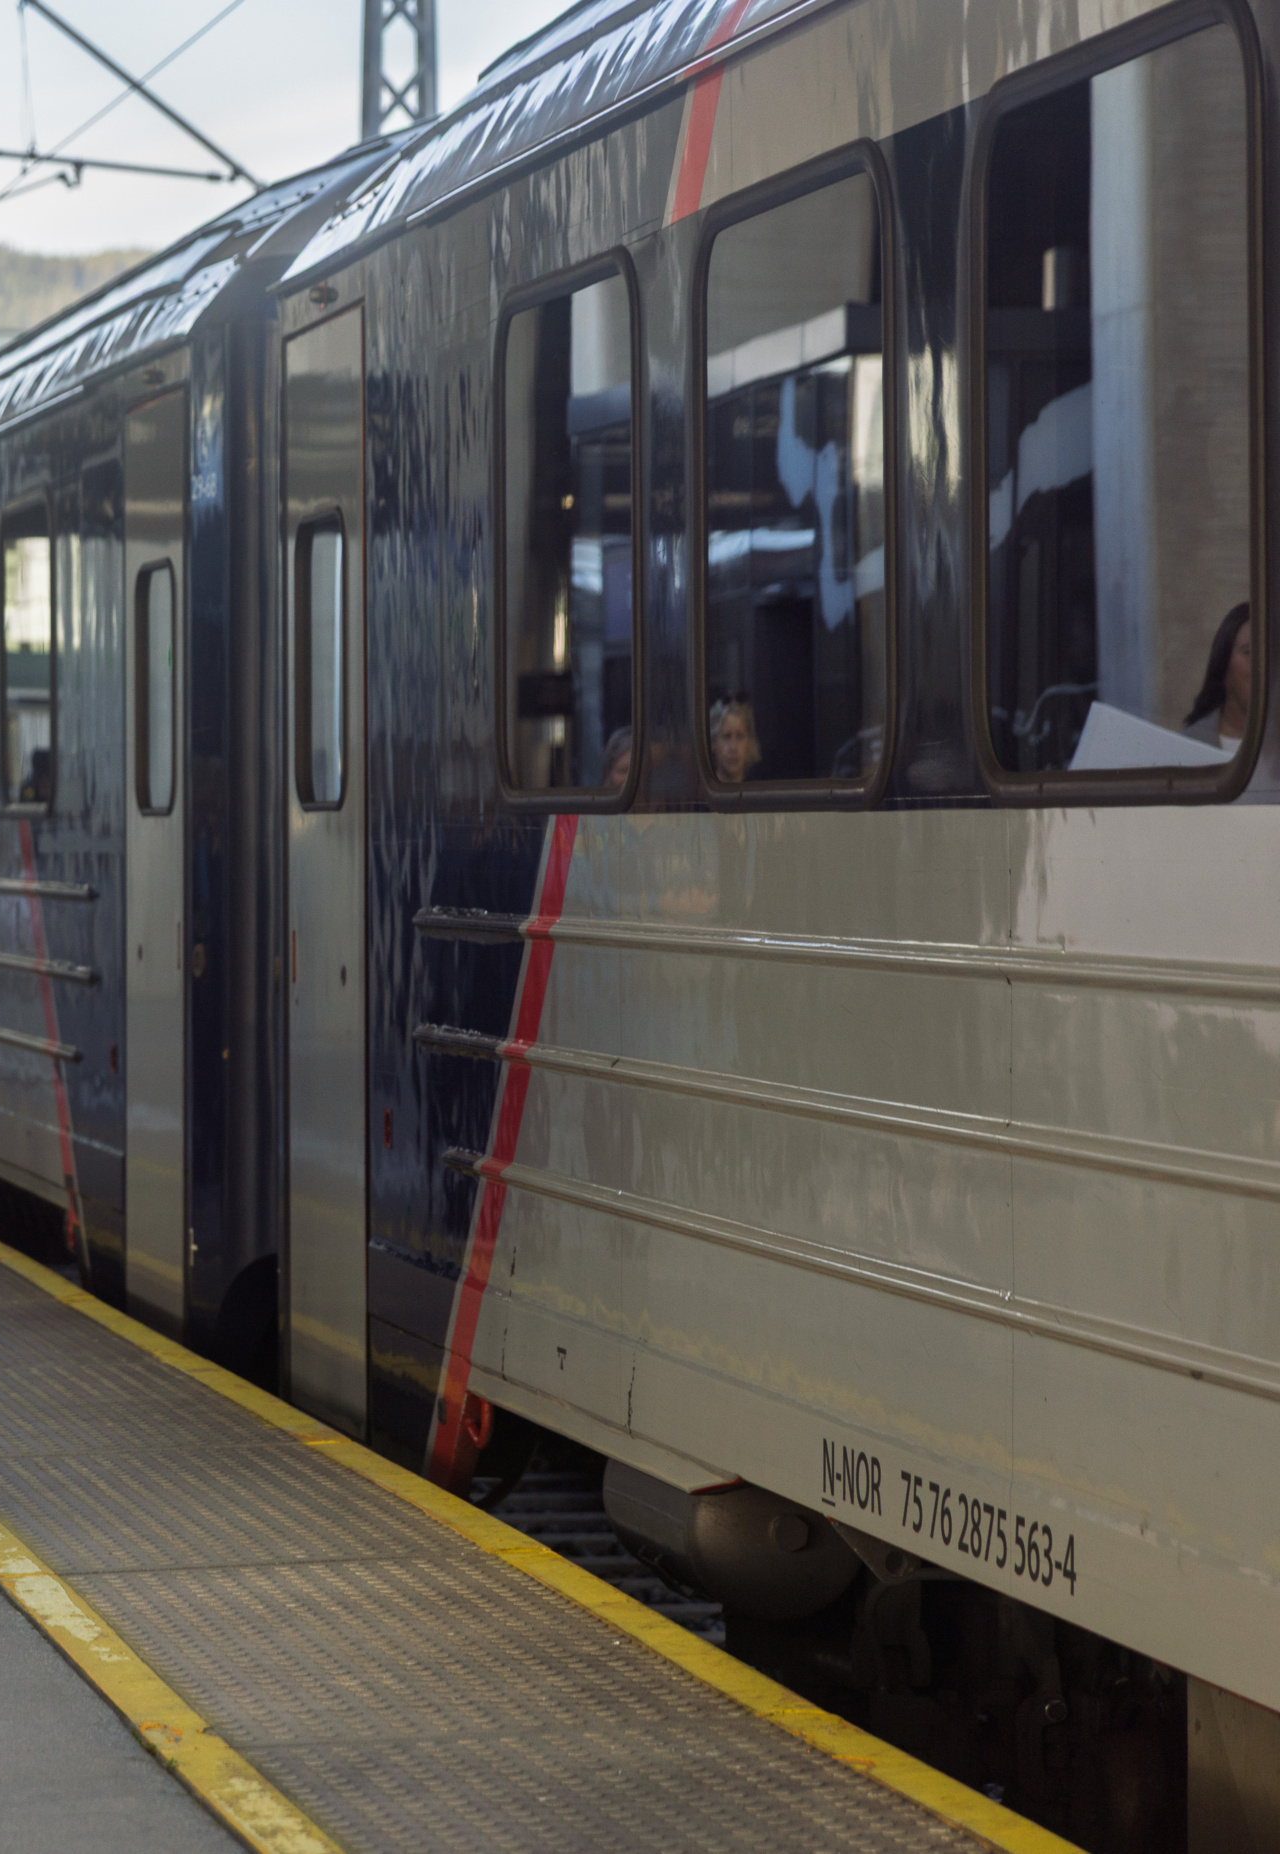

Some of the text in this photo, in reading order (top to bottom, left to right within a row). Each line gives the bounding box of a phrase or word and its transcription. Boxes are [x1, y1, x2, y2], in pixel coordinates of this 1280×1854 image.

[822, 1438, 882, 1516] N-NOR
[901, 1470, 923, 1533] 75
[929, 1481, 952, 1546] 76
[1014, 1515, 1077, 1596] 563-4
